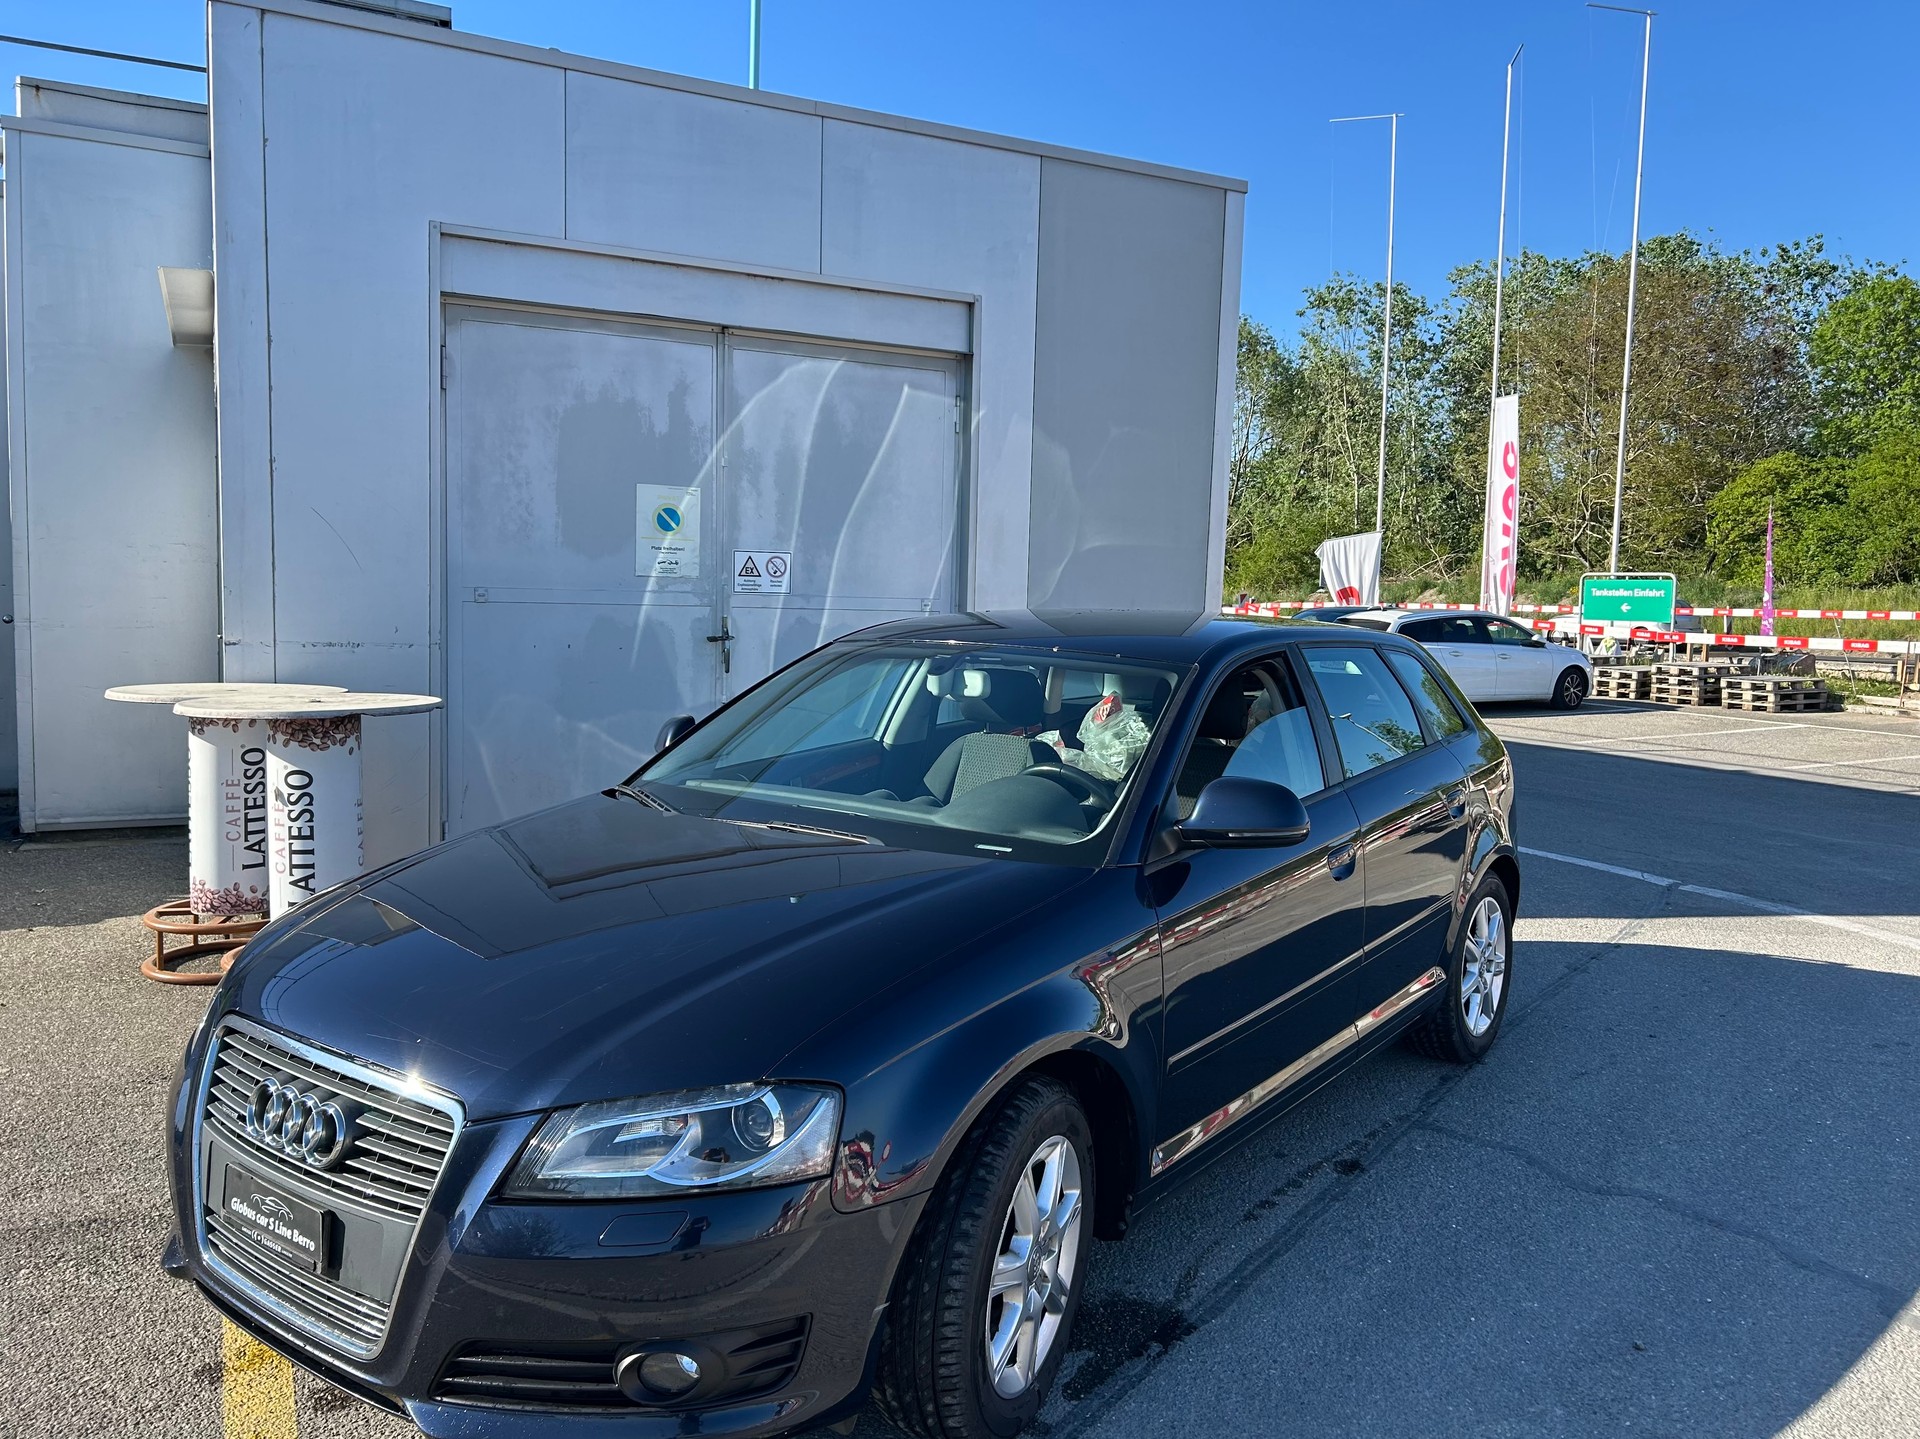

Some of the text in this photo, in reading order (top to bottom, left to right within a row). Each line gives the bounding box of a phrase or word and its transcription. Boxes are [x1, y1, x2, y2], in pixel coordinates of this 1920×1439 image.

[744, 566, 755, 575] EX
[1591, 587, 1666, 598] Tankstellen Einfahrt
[221, 778, 241, 842] CAFFÈ
[240, 747, 267, 871] LATTESSO
[272, 803, 287, 874] CAFFÈ
[231, 1197, 256, 1220] Globus
[256, 1212, 269, 1227] car
[268, 1216, 275, 1231] S
[274, 1219, 292, 1240] Line
[292, 1228, 316, 1252] Berro
